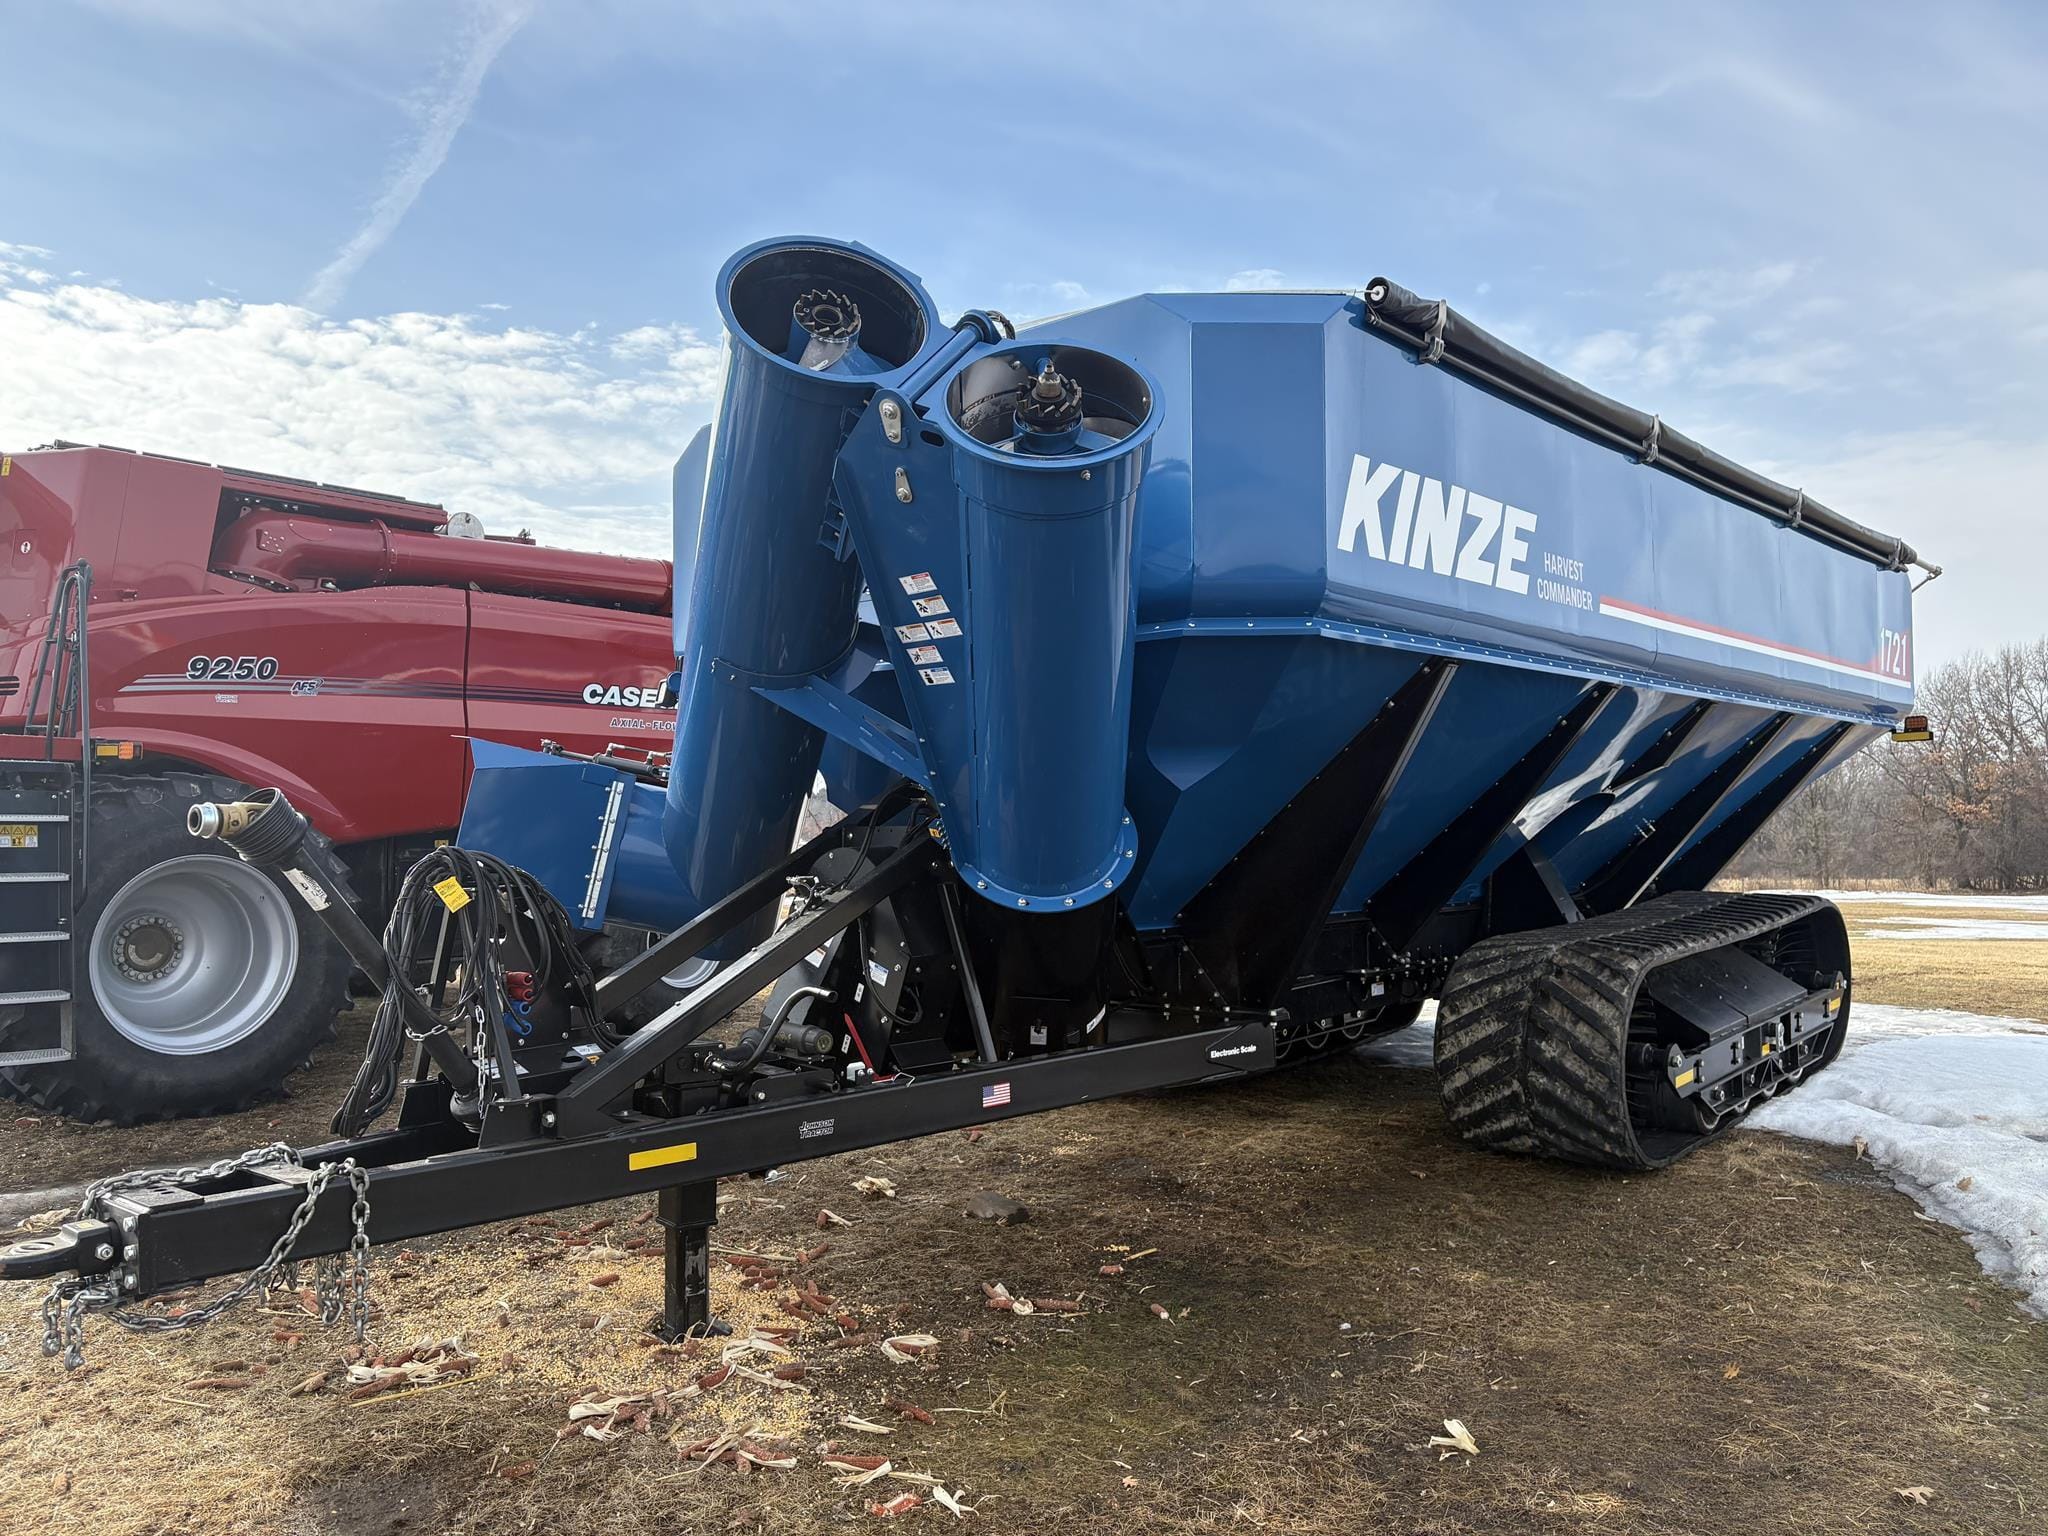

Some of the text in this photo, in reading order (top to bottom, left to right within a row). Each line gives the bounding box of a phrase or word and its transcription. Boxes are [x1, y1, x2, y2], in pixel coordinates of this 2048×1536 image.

[1337, 454, 1538, 595] KINZE
[1544, 551, 1583, 583] HARVEST
[1537, 577, 1594, 612] COMMANDER
[1881, 627, 1907, 677] 1721
[186, 655, 279, 682] 9250
[291, 680, 317, 692] AFS
[582, 683, 659, 709] CASE
[1210, 1044, 1257, 1058] Electronic Scale
